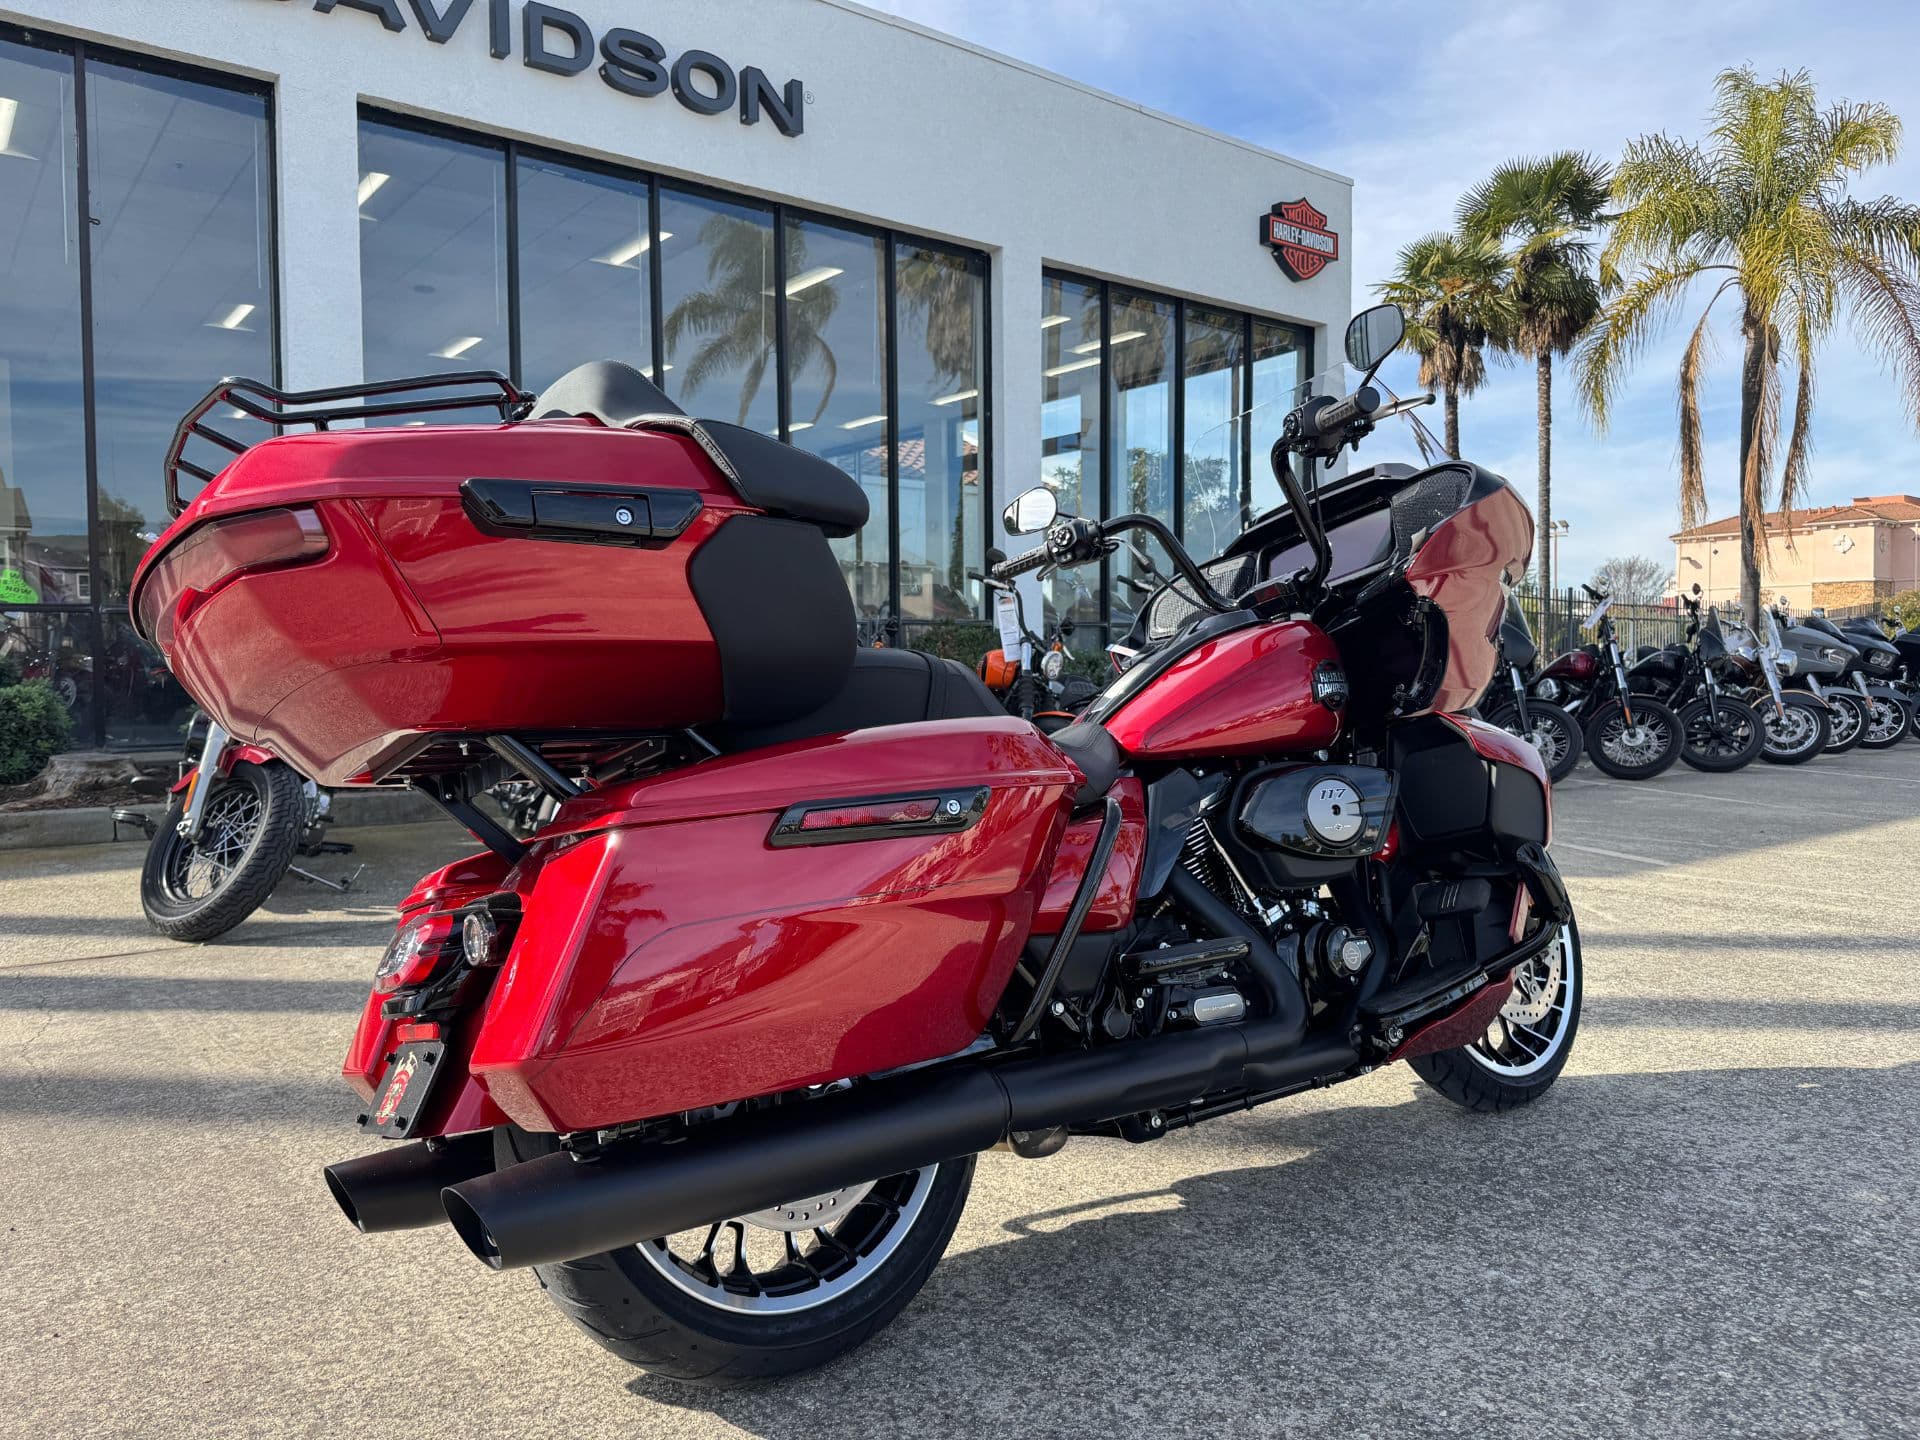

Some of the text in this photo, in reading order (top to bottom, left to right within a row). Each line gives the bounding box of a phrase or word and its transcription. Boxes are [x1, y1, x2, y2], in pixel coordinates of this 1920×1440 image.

[313, 0, 804, 138] VIDSON
[1288, 208, 1320, 228] MOTOR
[1273, 221, 1334, 254] HARLEY-DAVIDSON
[1288, 249, 1319, 273] CYCLES
[1320, 788, 1346, 800] 117
